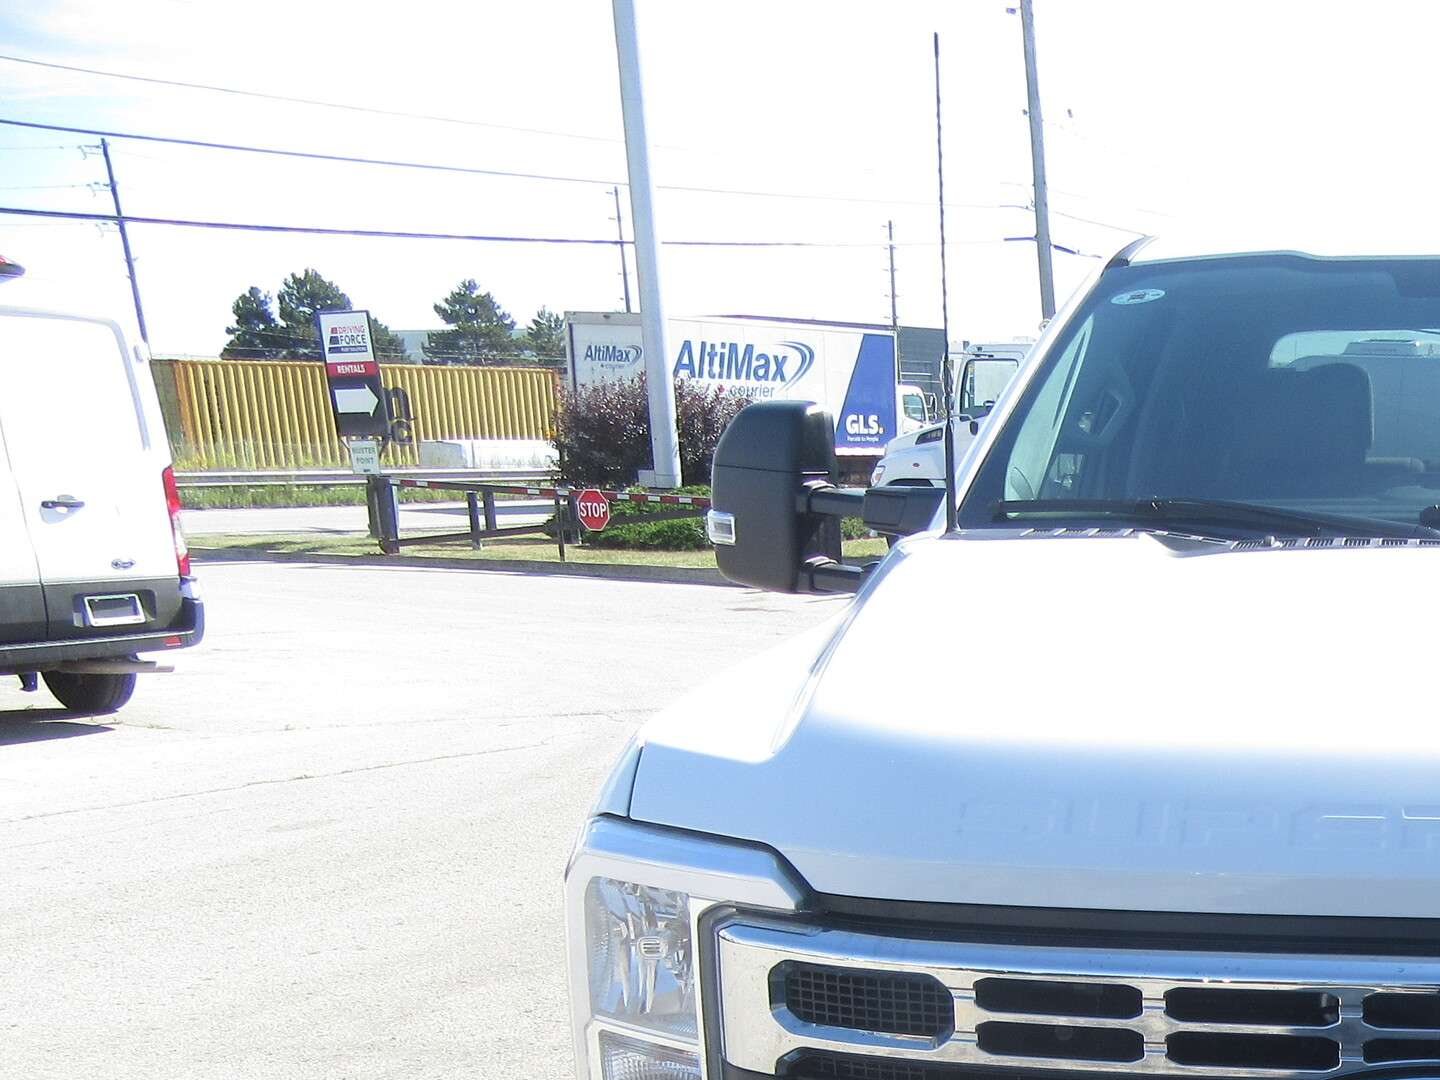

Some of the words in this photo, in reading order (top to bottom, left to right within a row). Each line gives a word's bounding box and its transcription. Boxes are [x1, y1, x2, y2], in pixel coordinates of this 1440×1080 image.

[338, 325, 365, 334] DRIVING
[340, 335, 366, 344] FORCE
[584, 344, 631, 363] AltiMax
[673, 340, 788, 382] AltiMax
[337, 364, 365, 374] RENTALS
[580, 502, 607, 518] STOP
